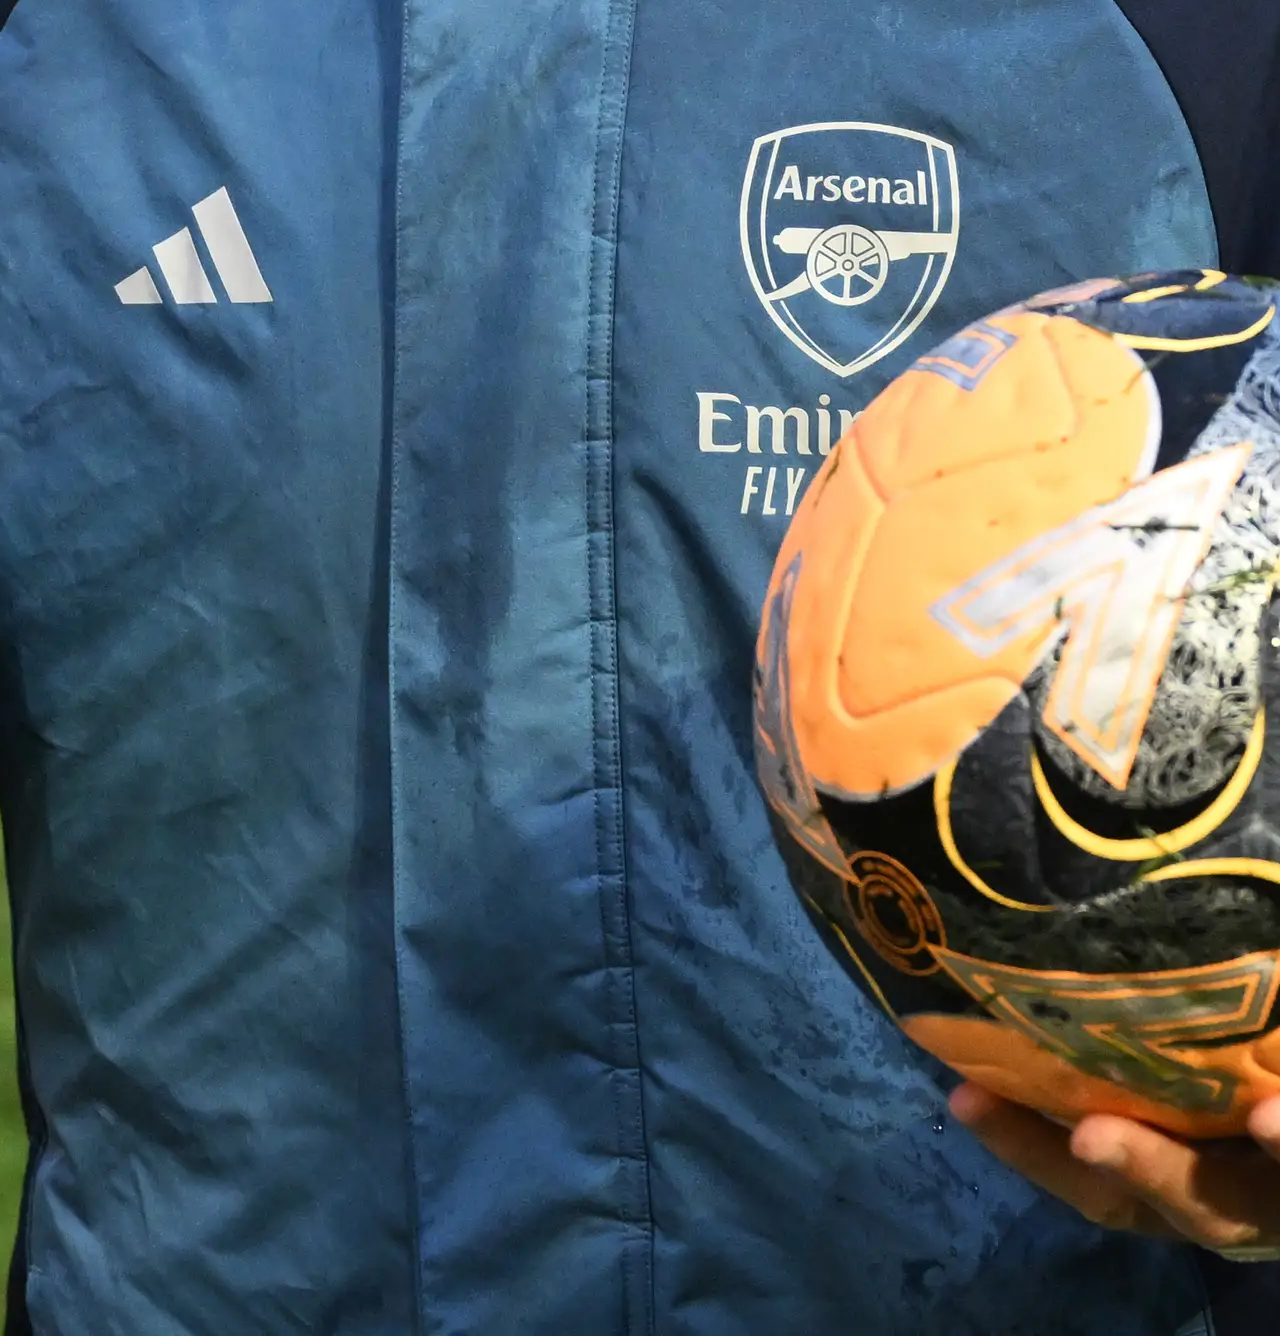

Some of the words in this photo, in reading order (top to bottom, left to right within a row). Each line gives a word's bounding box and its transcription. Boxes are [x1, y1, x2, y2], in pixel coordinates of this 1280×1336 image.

[773, 165, 928, 205] Arsenal
[696, 392, 865, 456] Emir
[740, 466, 806, 516] FLY
